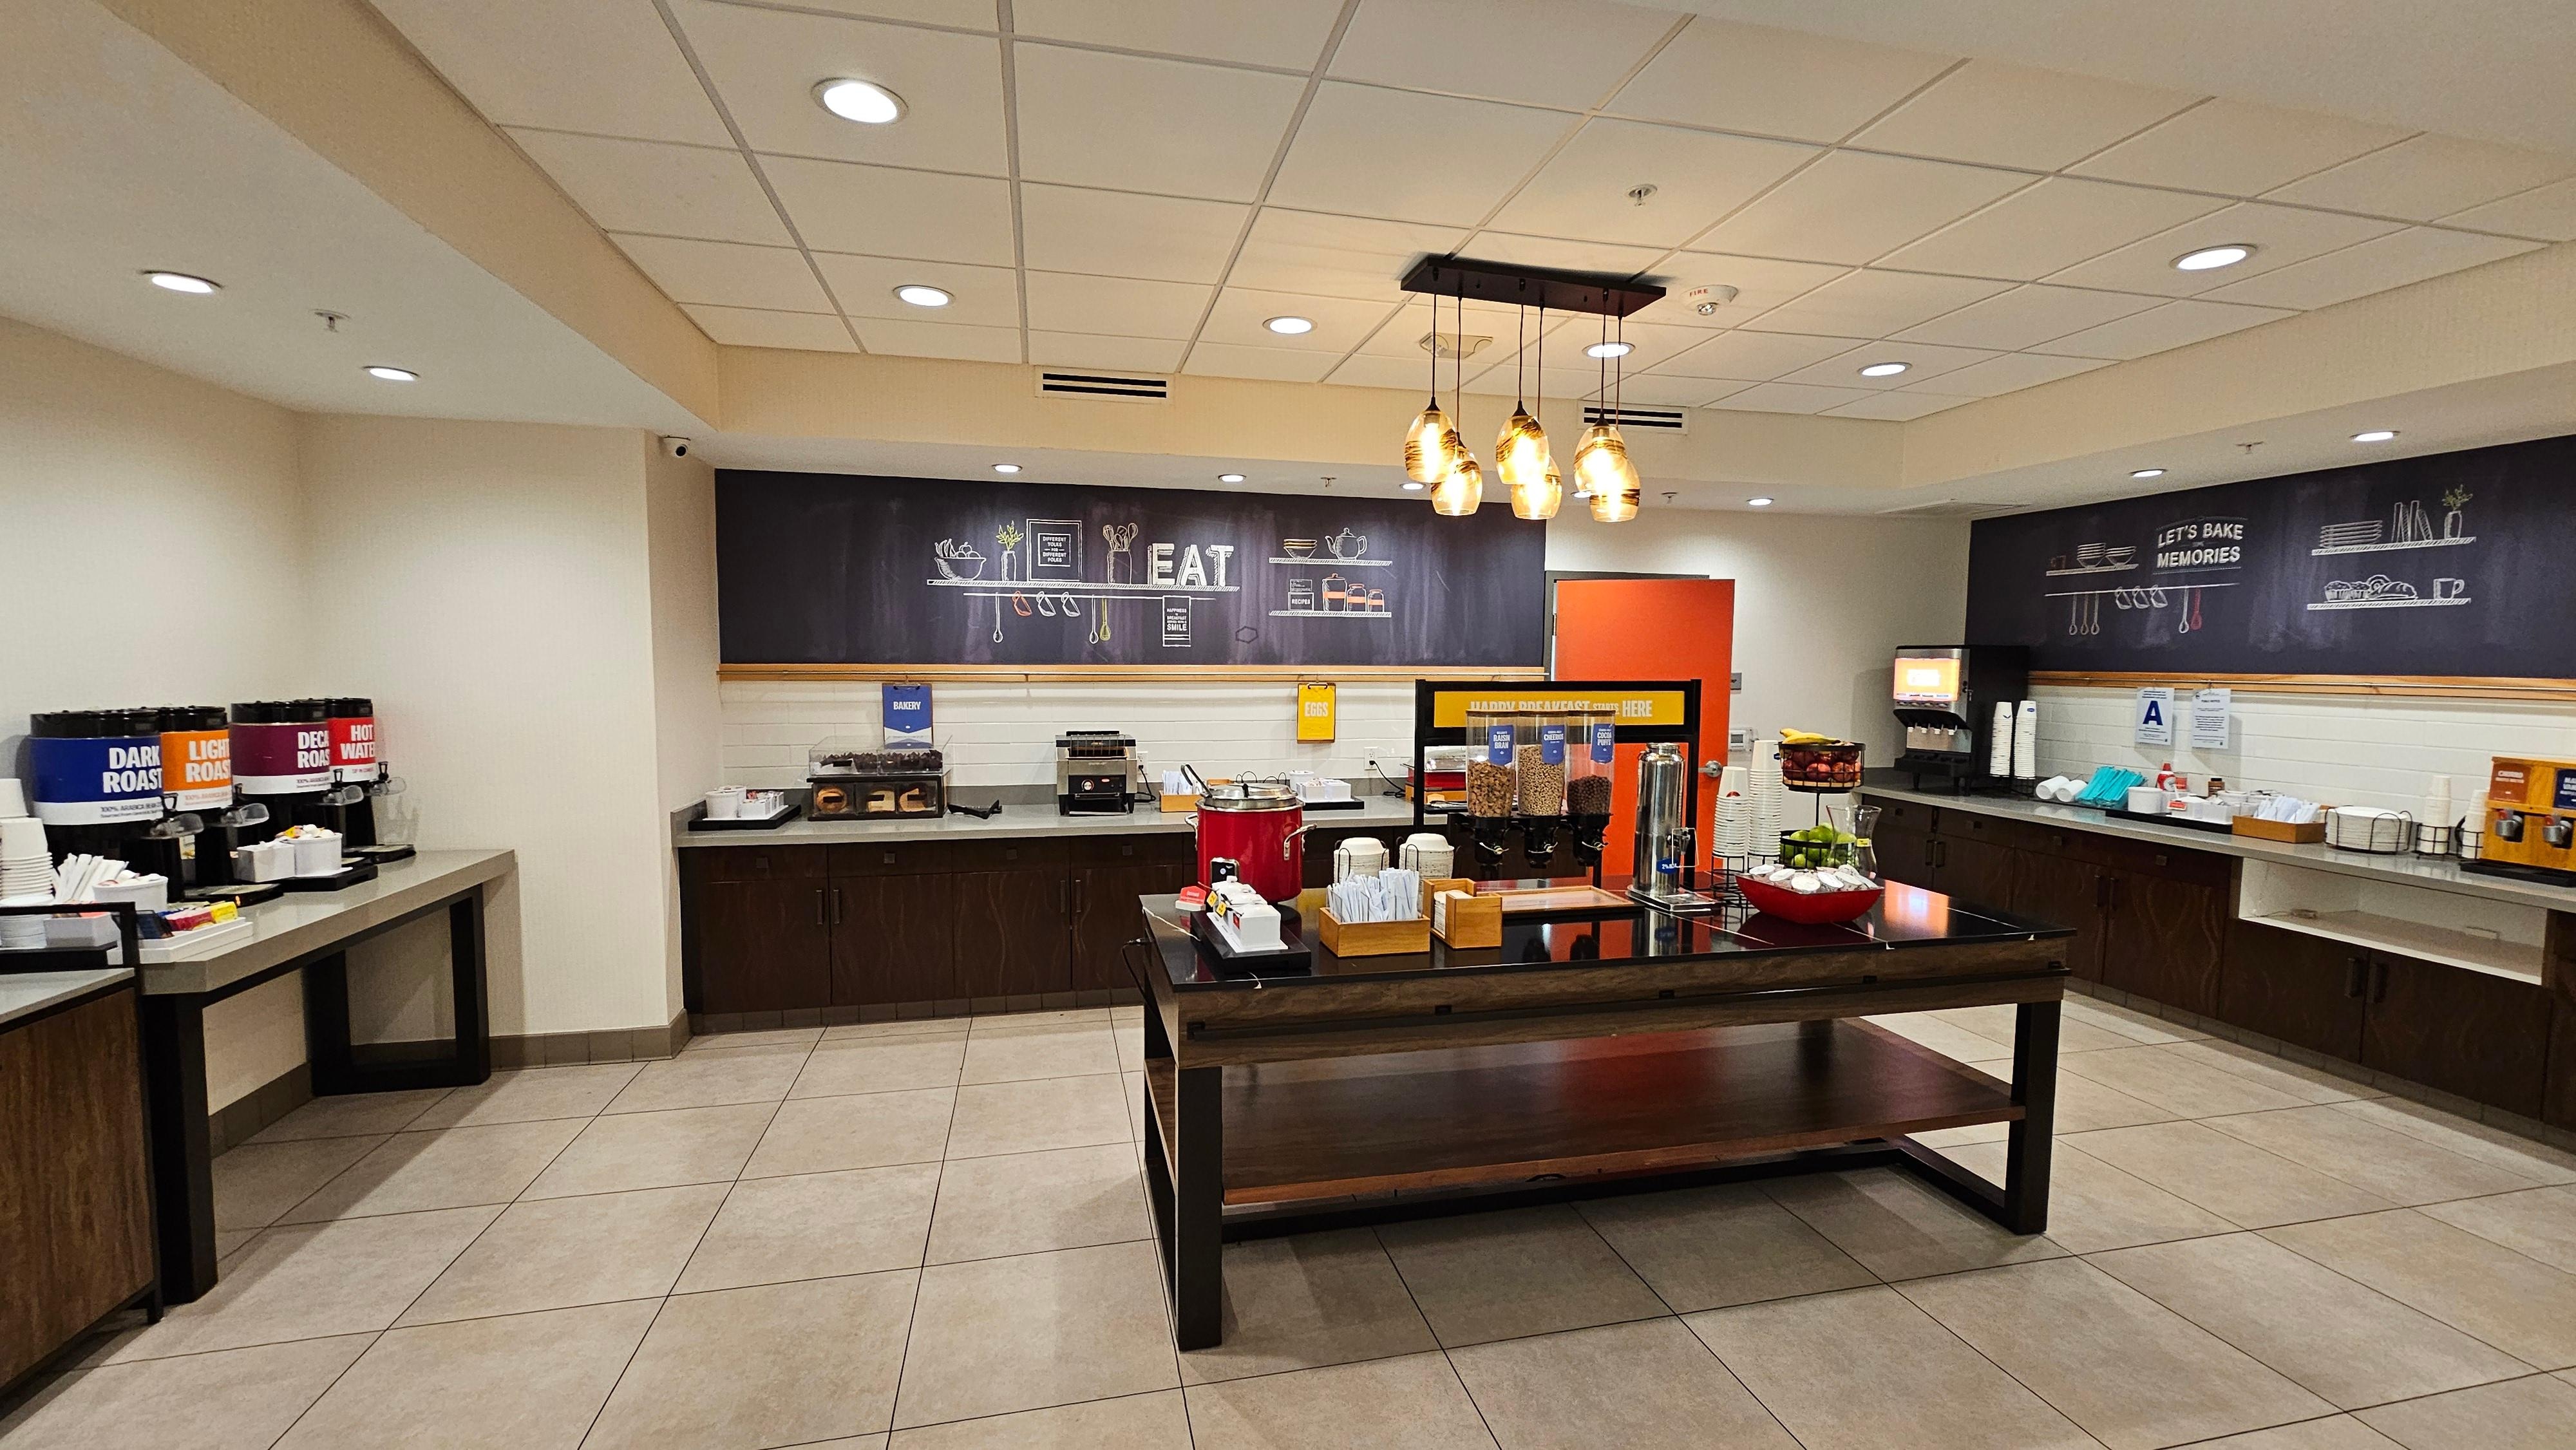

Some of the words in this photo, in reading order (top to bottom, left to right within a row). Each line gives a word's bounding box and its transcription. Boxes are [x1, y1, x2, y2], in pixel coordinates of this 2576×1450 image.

[1689, 288, 1709, 297] FIRE
[2157, 524, 2197, 549] LET'S
[2202, 523, 2244, 540] BAKE
[1148, 543, 1234, 587] EAT
[2157, 546, 2240, 569] MEMORIES
[893, 701, 921, 710] BAKERY
[1305, 702, 1329, 717] EGGS
[1622, 700, 1653, 717] HERE
[2143, 700, 2163, 726] A
[298, 730, 329, 749] DECA
[350, 724, 374, 741] HOT
[109, 745, 160, 769] DARK
[189, 738, 230, 760] LIGHT
[297, 748, 330, 768] ROAS
[340, 741, 375, 759] WATE
[102, 768, 162, 793] ROAST
[185, 758, 231, 783] ROAS
